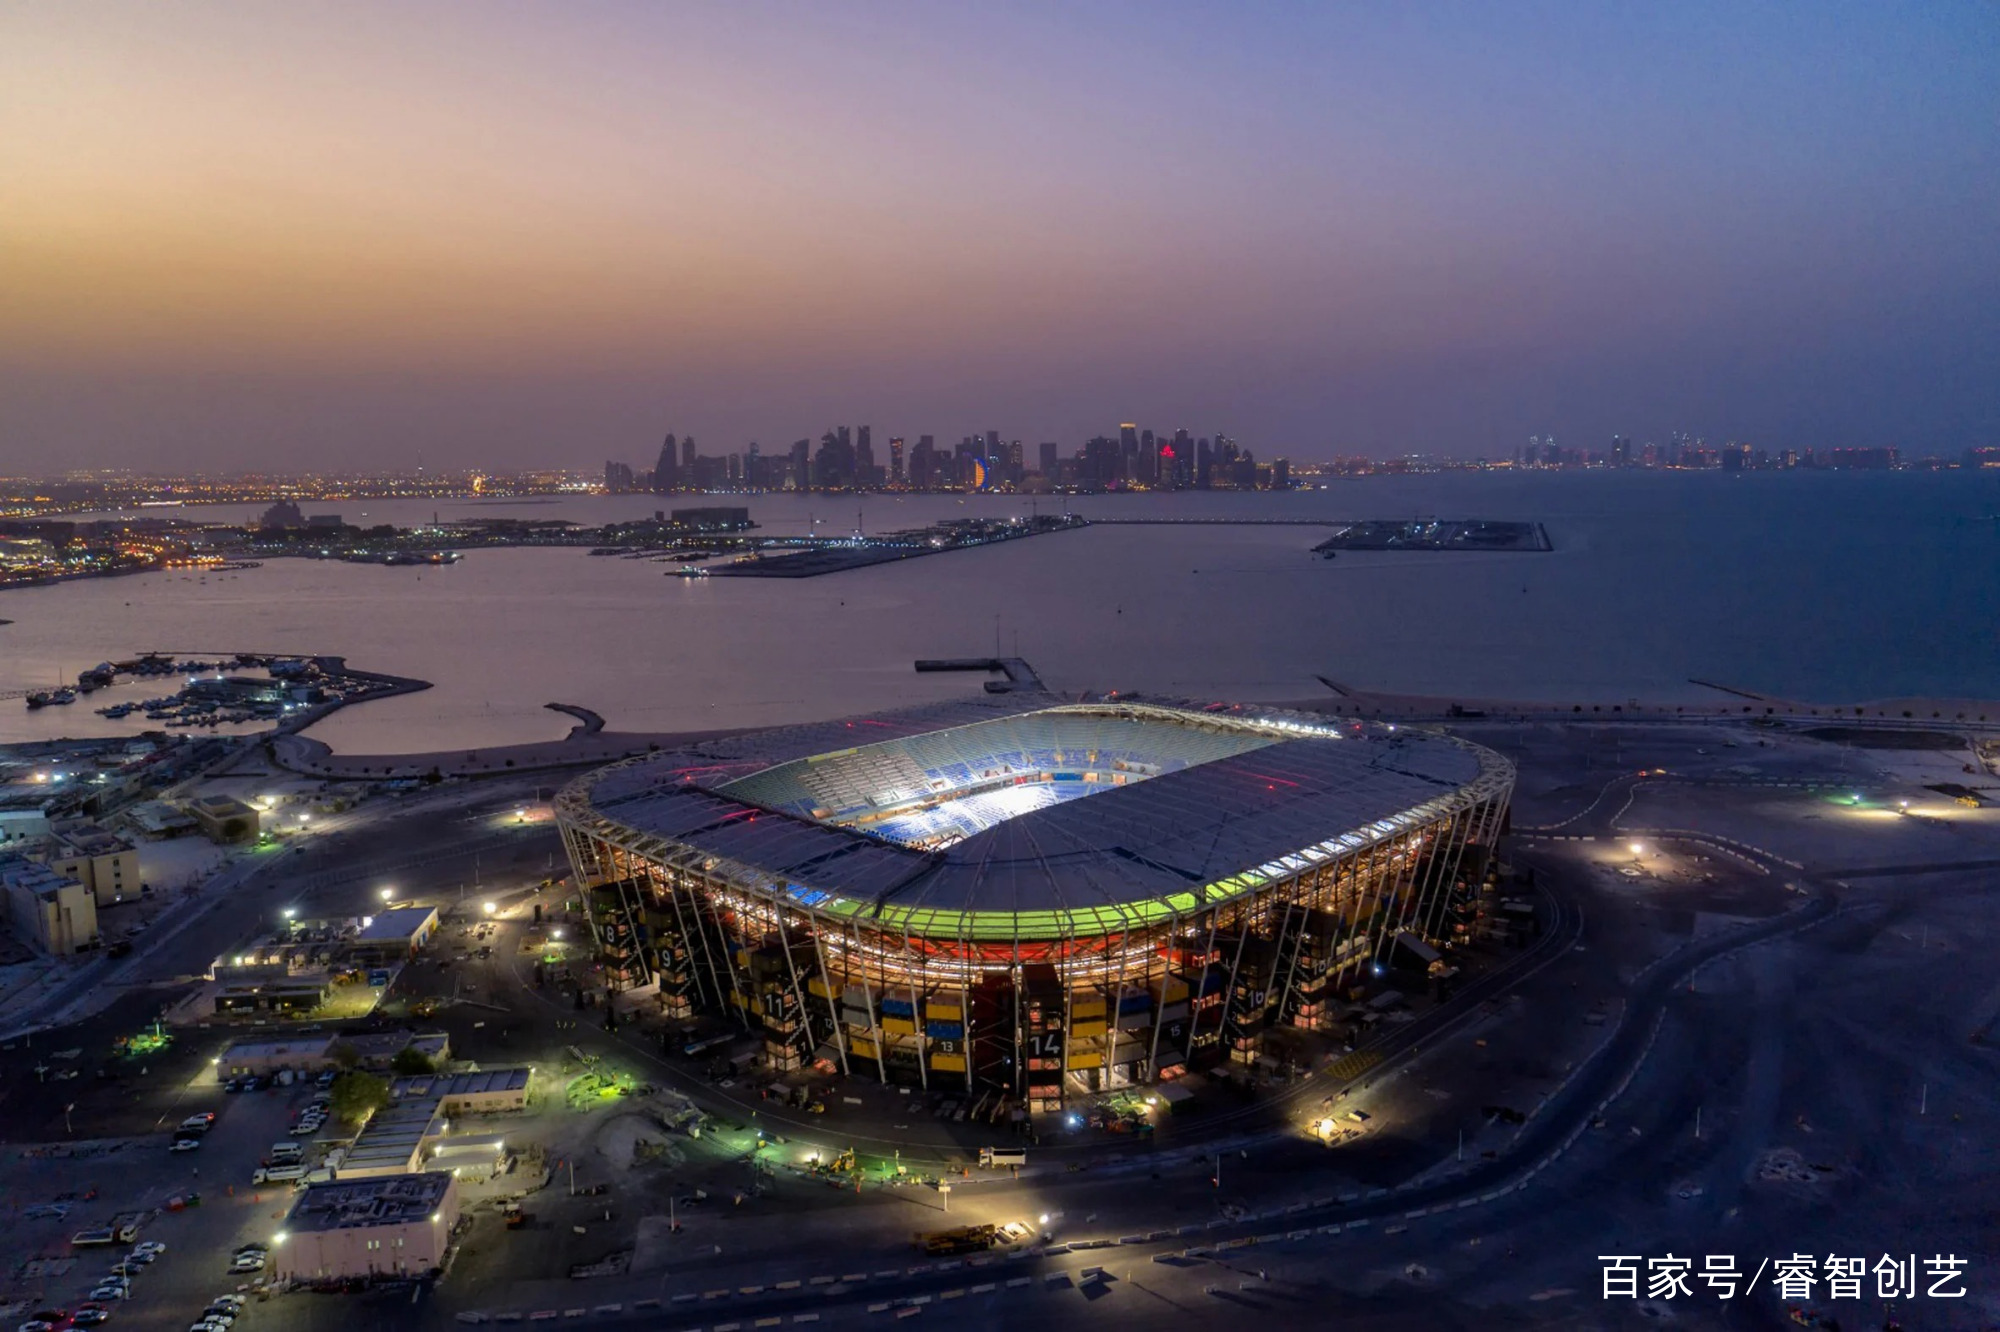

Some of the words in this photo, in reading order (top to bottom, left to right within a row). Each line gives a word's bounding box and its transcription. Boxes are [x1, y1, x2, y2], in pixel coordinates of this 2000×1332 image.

[606, 925, 615, 942] 8
[662, 949, 671, 967] 9
[765, 994, 783, 1018] 11
[1170, 1024, 1181, 1037] 15
[941, 1041, 954, 1053] 13
[1030, 1033, 1060, 1056] 14
